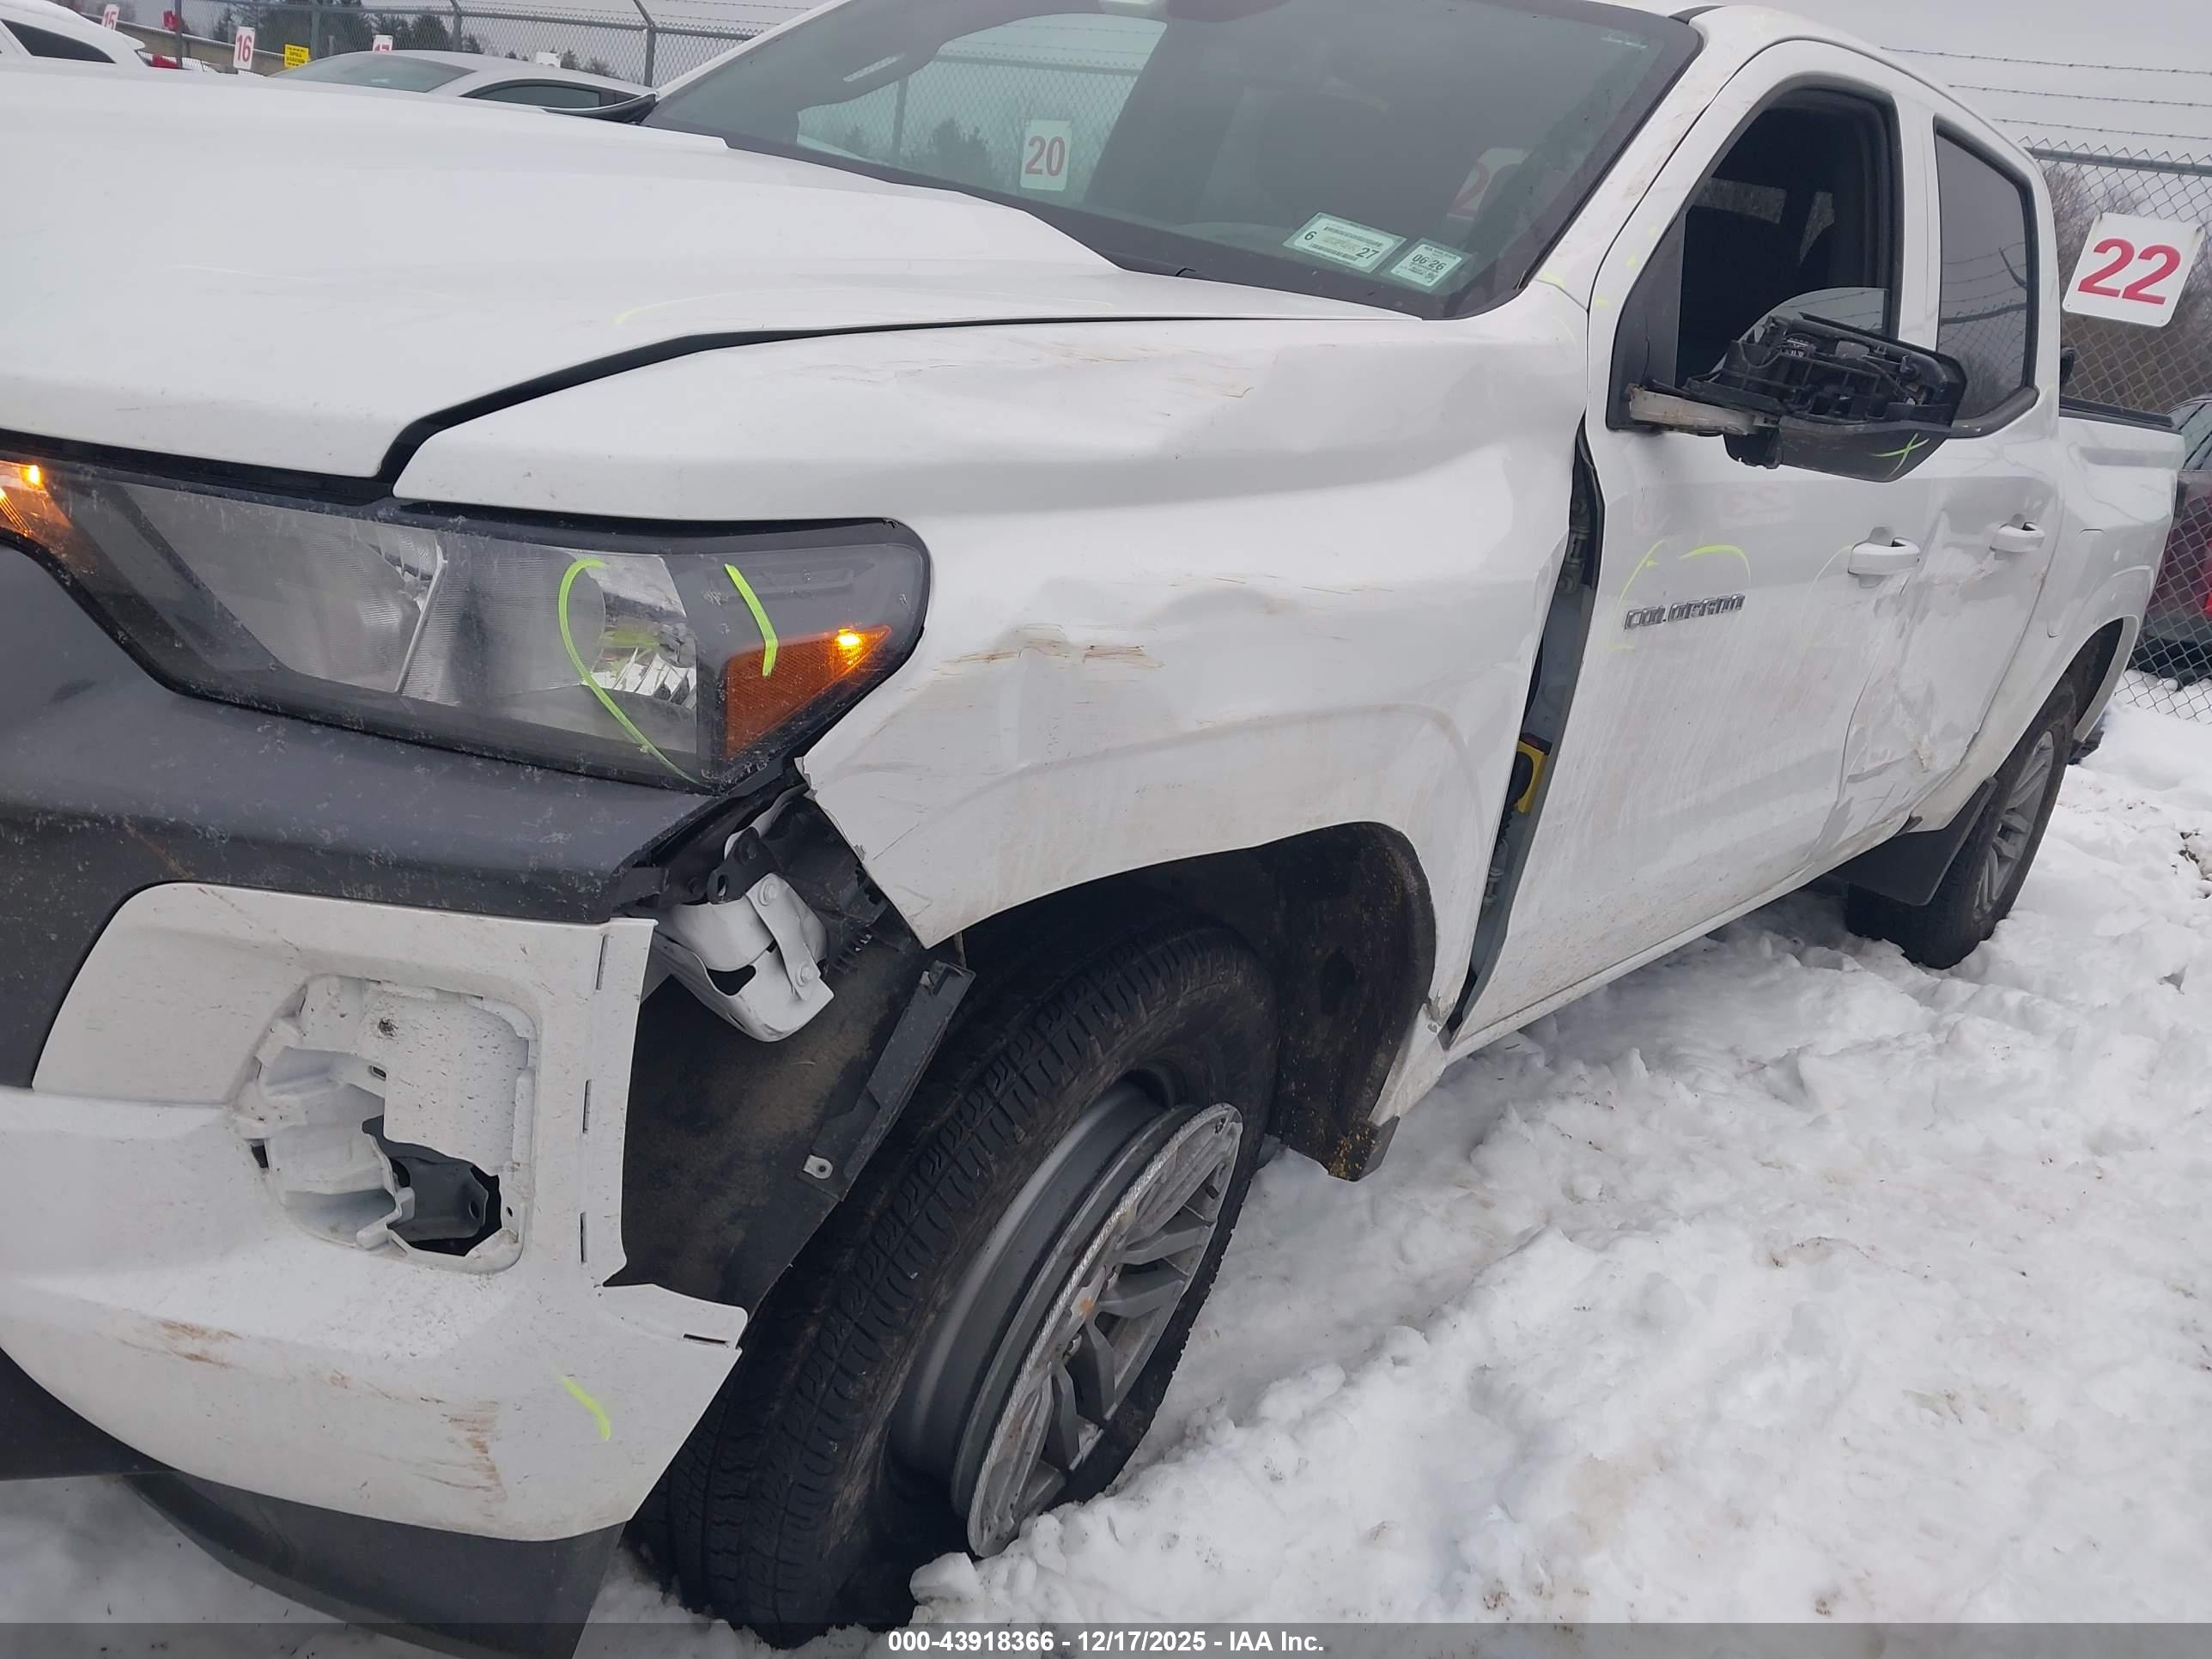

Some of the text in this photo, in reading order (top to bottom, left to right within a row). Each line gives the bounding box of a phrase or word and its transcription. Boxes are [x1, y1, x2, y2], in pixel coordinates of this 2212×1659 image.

[236, 34, 252, 63] 16
[1024, 135, 1066, 177] 20
[1304, 230, 1317, 241] 6
[1355, 246, 1380, 259] 27
[1412, 253, 1430, 264] 06
[1428, 259, 1447, 270] 26
[2077, 237, 2182, 306] 22
